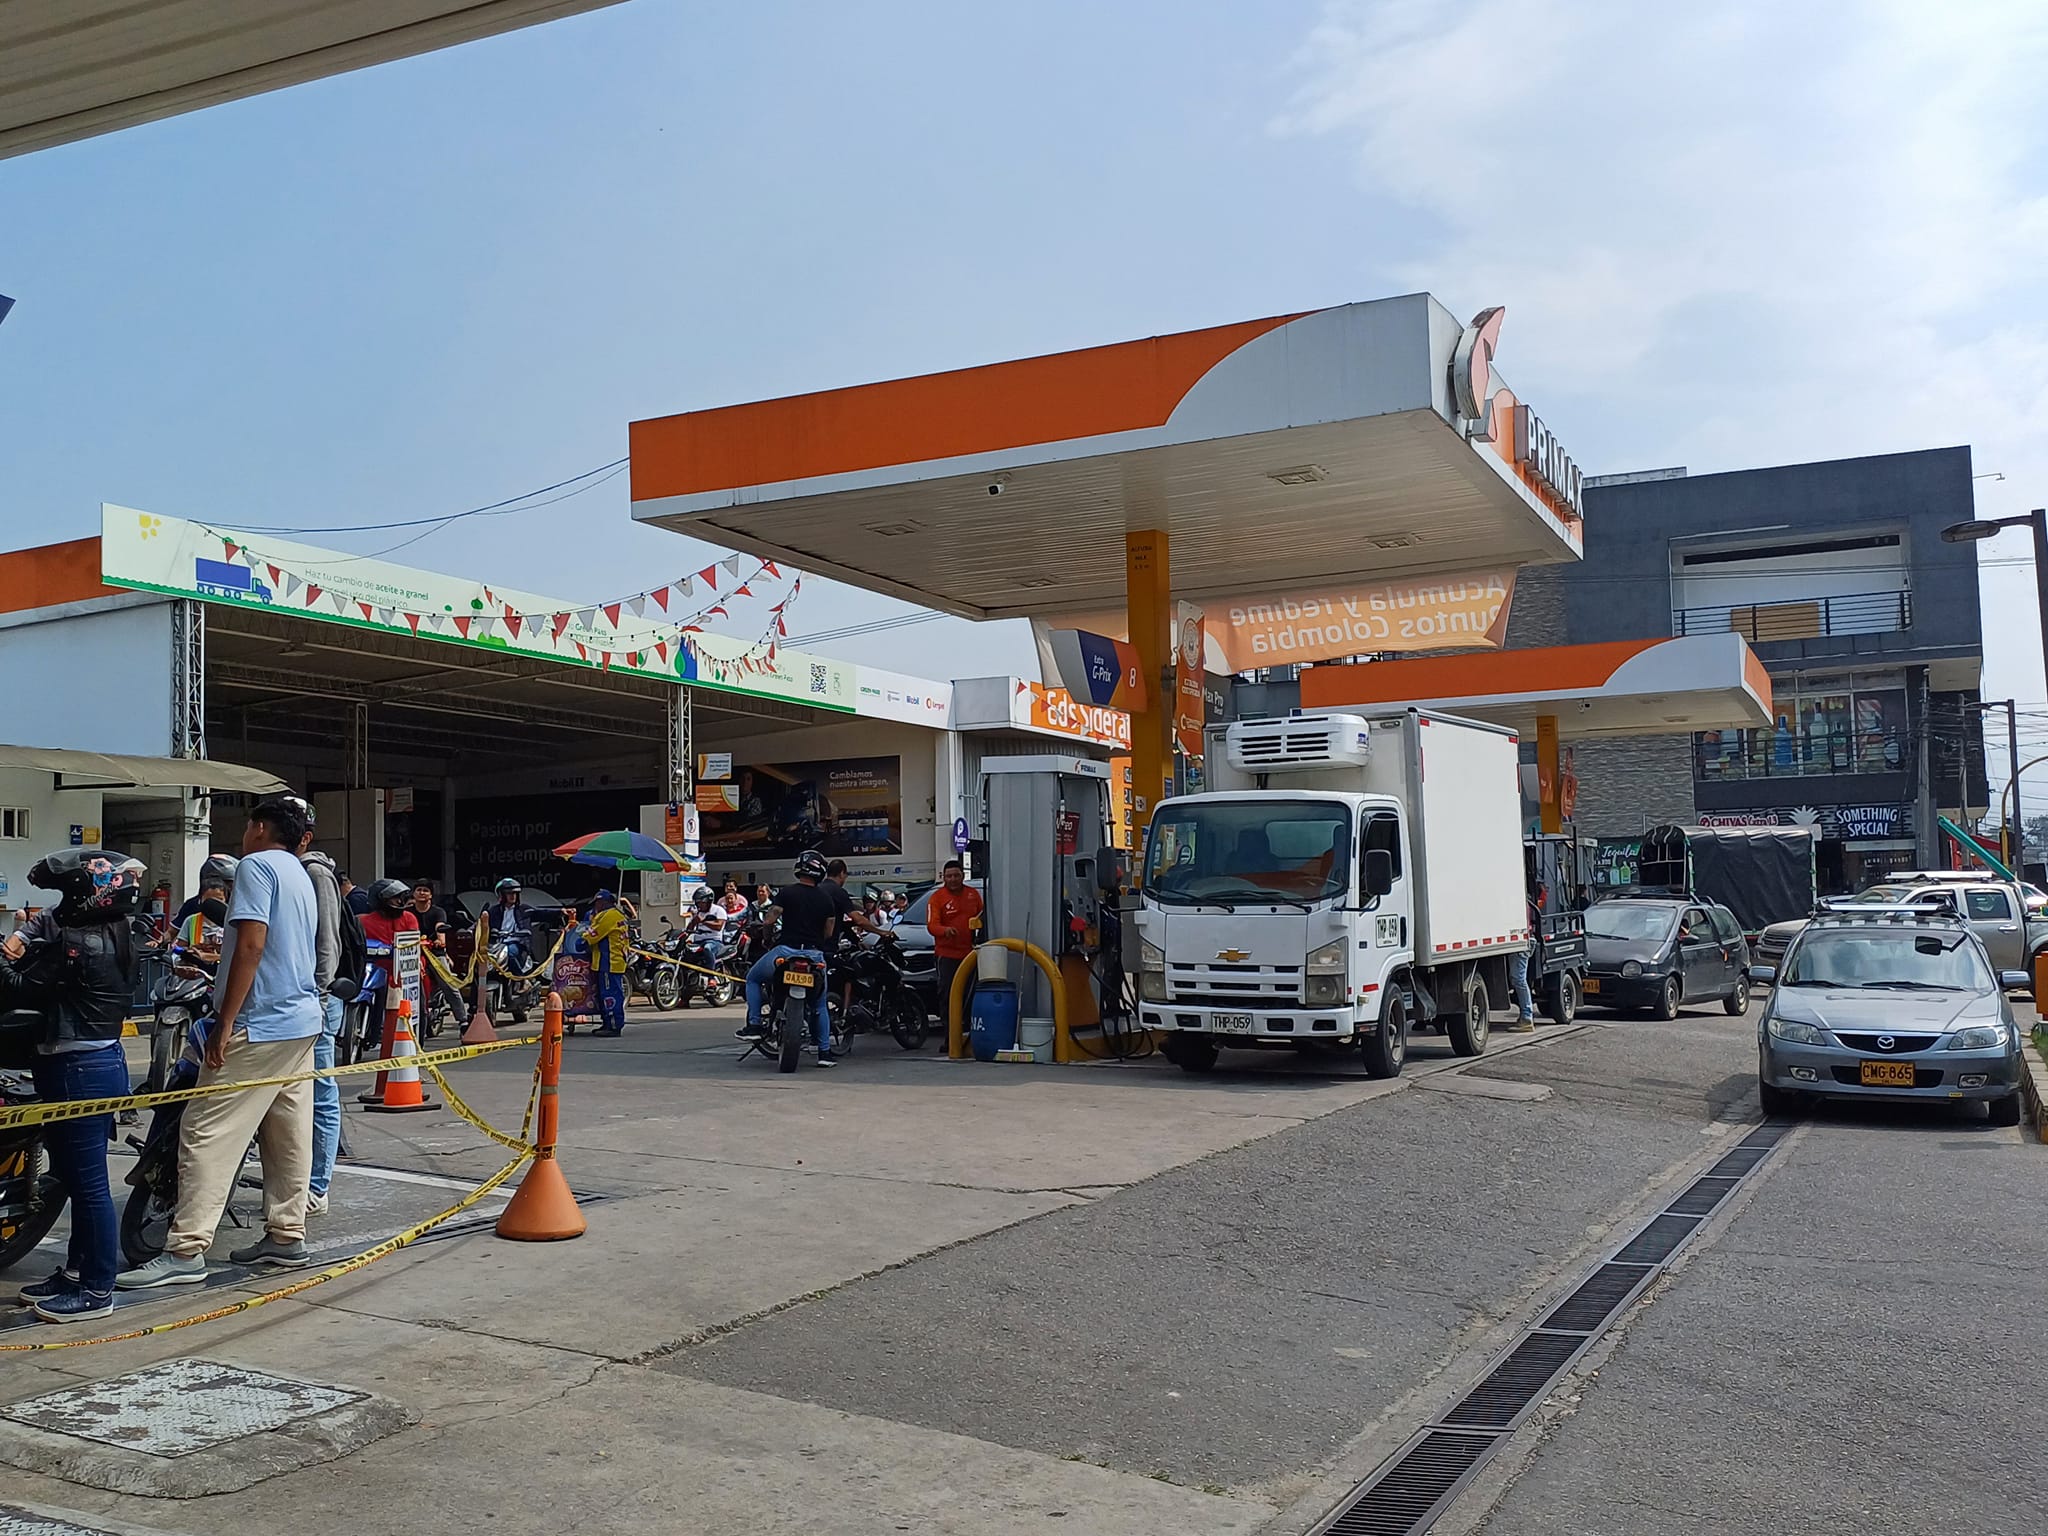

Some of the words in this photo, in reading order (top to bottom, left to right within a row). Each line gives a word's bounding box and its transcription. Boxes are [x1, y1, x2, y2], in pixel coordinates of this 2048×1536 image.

[1526, 405, 1584, 520] PRIMAX
[305, 569, 320, 580] Haz
[323, 573, 332, 581] tu
[333, 575, 363, 587] cambio
[364, 581, 374, 590] de
[375, 584, 398, 595] aceite
[405, 589, 429, 601] granel
[1092, 665, 1112, 683] G-Prix
[1129, 667, 1137, 688] 8
[906, 695, 920, 705] Mobil
[829, 770, 873, 780] Cambiamos
[829, 780, 858, 789] nuestra
[1711, 815, 1748, 827] CHIVAS
[1836, 807, 1899, 824] SOMETHING
[470, 818, 520, 838] Pasión
[525, 821, 552, 840] por
[1847, 822, 1890, 837] SPECIAL
[470, 846, 482, 864] el
[470, 875, 488, 888] en
[1213, 1015, 1251, 1029] THP-059
[1862, 1064, 1913, 1080] CMG-865
